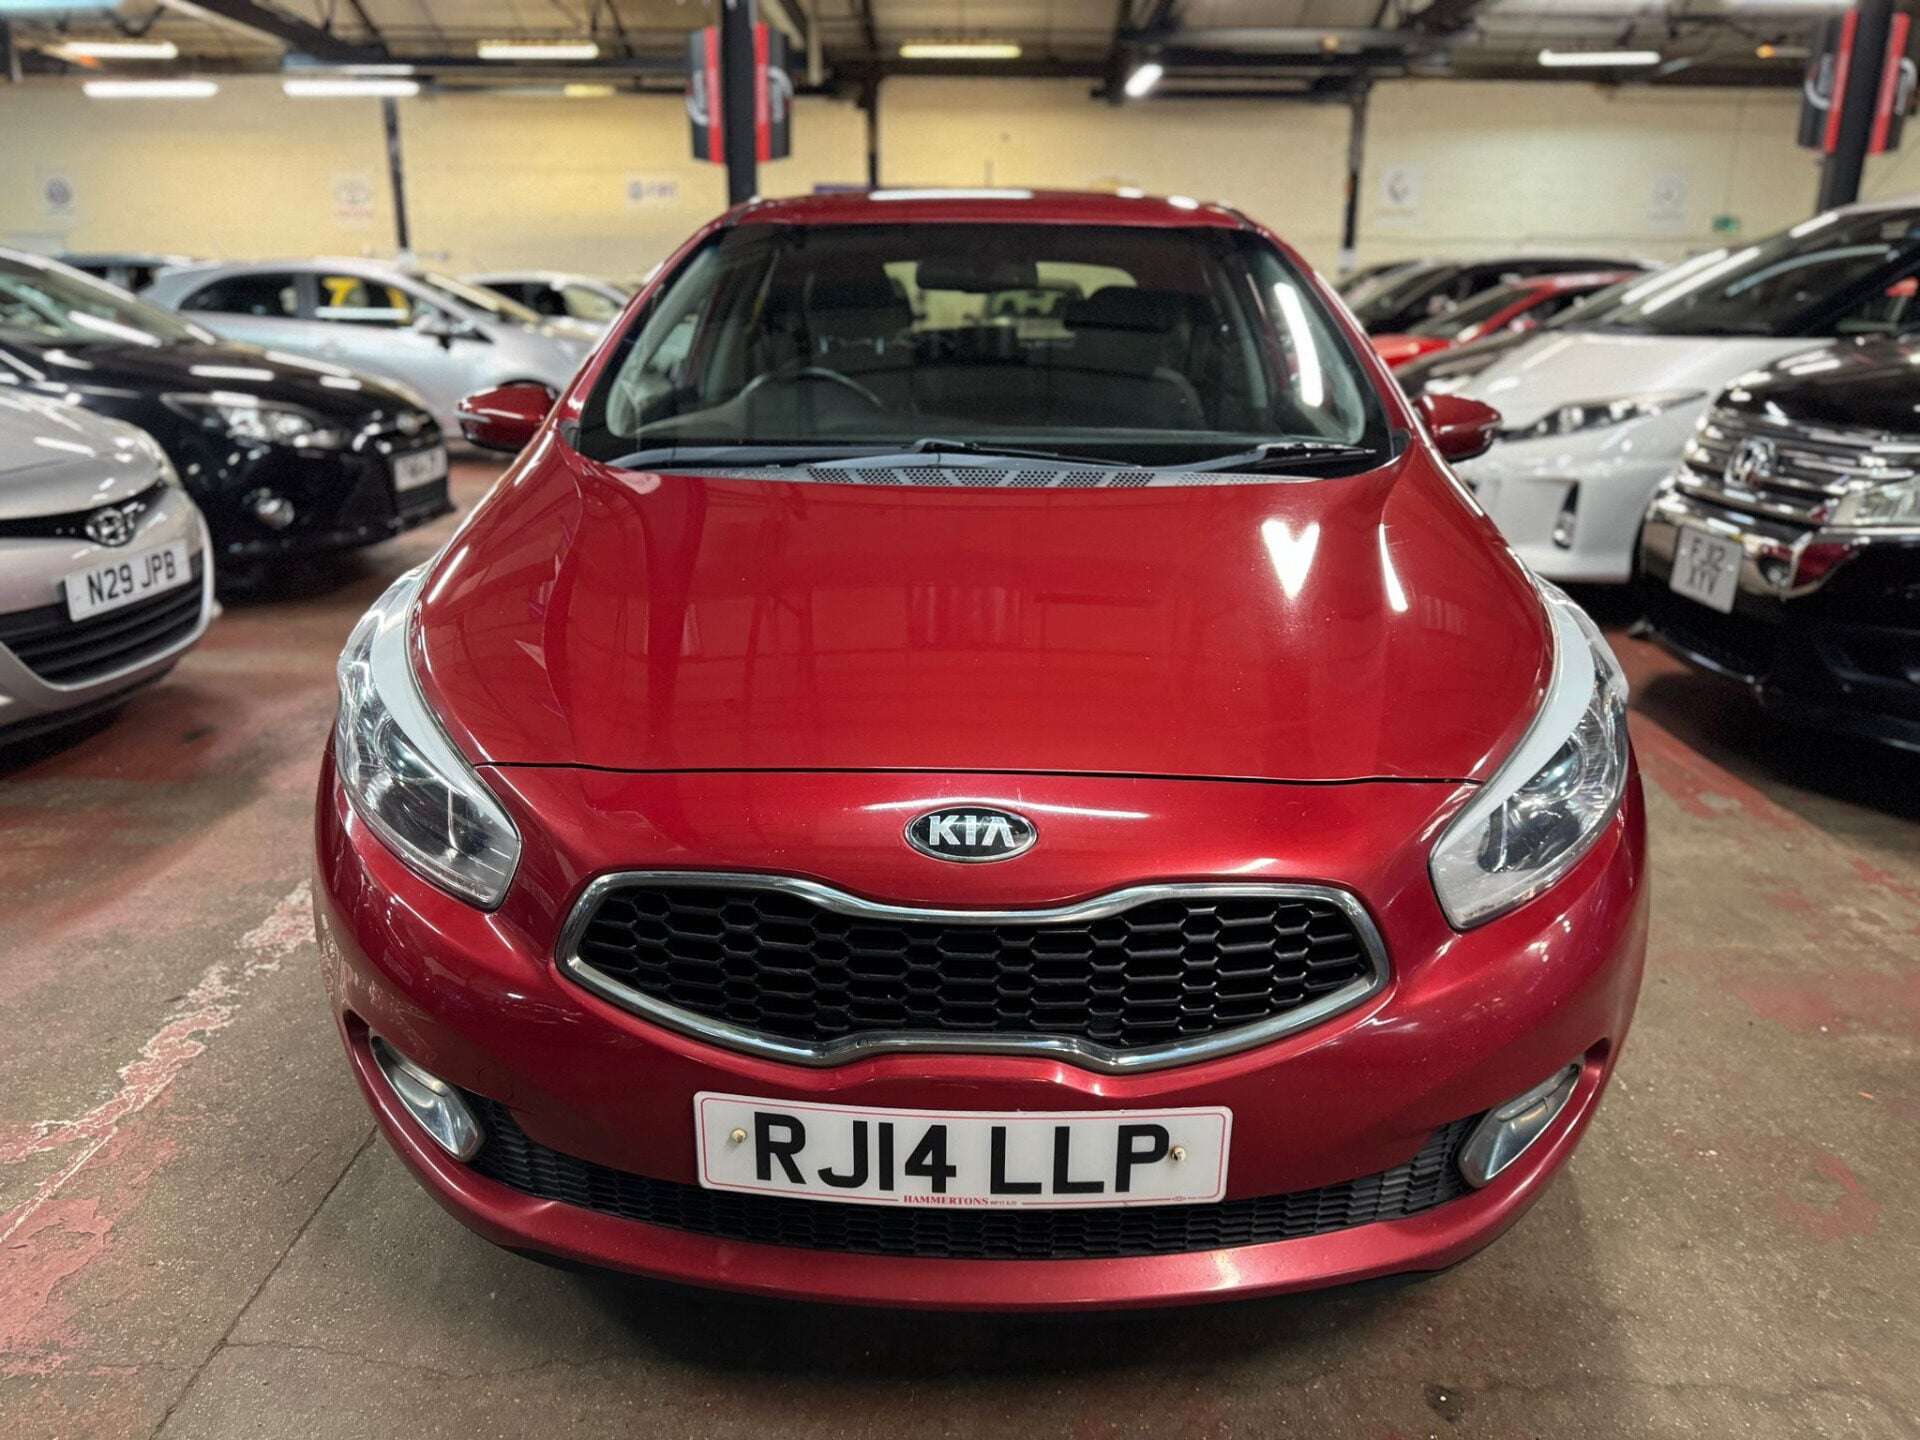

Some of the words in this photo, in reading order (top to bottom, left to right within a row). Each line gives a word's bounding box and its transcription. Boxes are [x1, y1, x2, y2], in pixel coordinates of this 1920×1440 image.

[87, 564, 135, 605] N29
[141, 550, 176, 588] JPB
[929, 815, 1016, 847] KIA
[754, 1111, 957, 1194] RJ14
[990, 1123, 1171, 1195] LLP
[903, 1195, 989, 1206] HAMMERTONS
